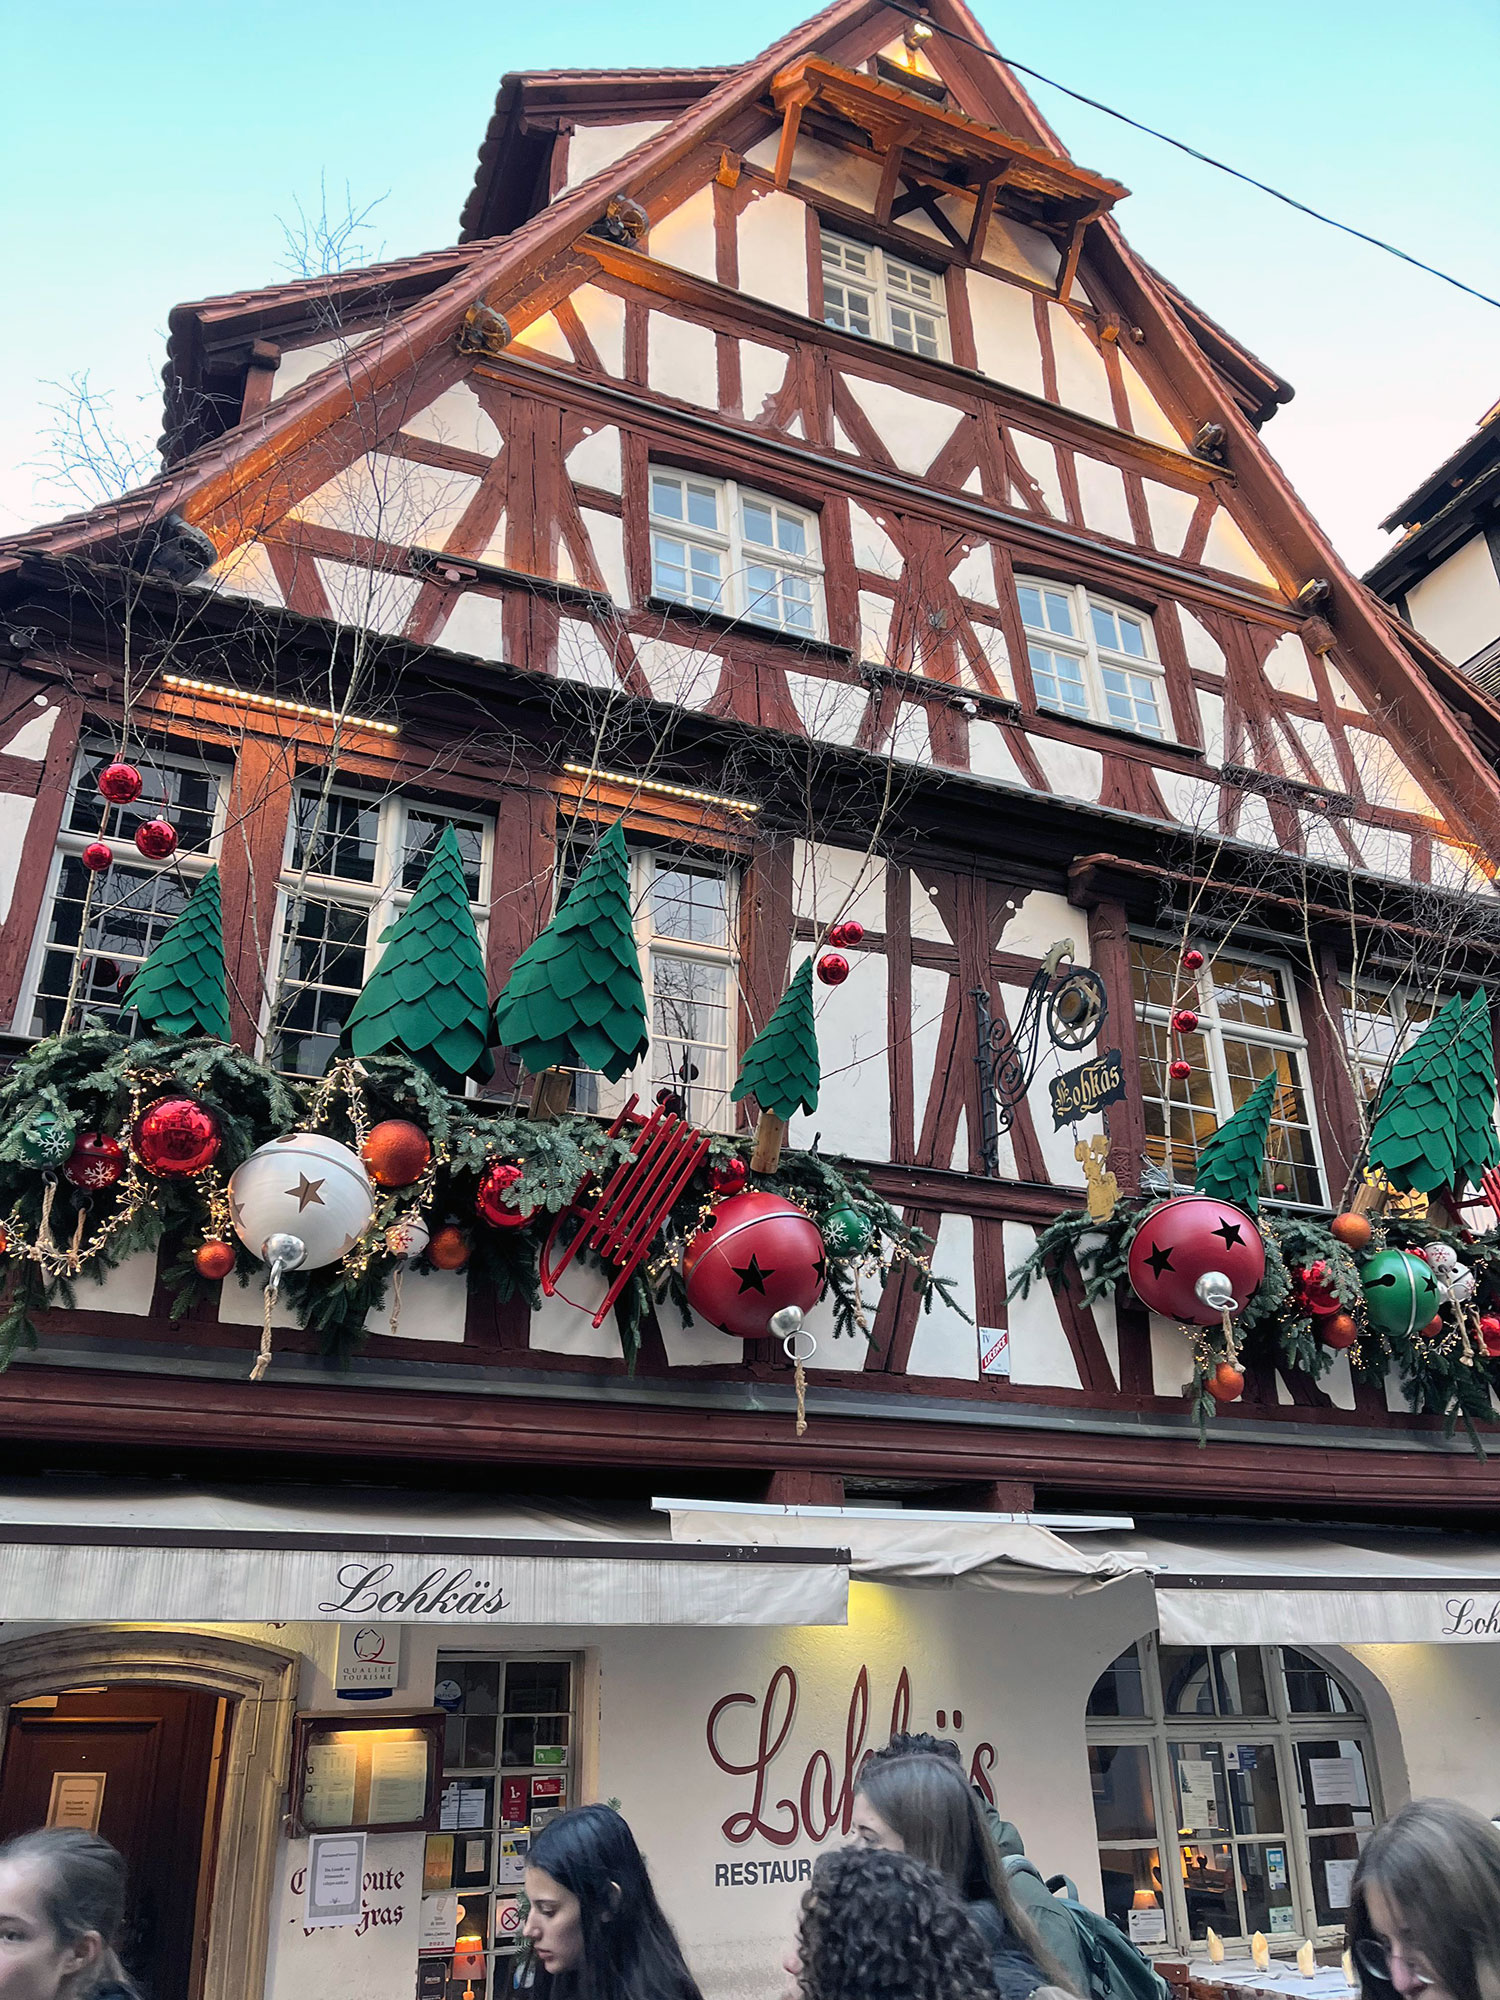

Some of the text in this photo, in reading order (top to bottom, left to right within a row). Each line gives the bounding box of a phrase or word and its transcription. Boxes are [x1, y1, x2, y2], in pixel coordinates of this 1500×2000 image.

[1055, 1057, 1120, 1117] Lohkäs
[984, 1336, 1006, 1367] LICENCE
[318, 1563, 511, 1614] Lohkäs
[1441, 1598, 1500, 1634] Loh
[715, 1858, 812, 1887] RESTAUR
